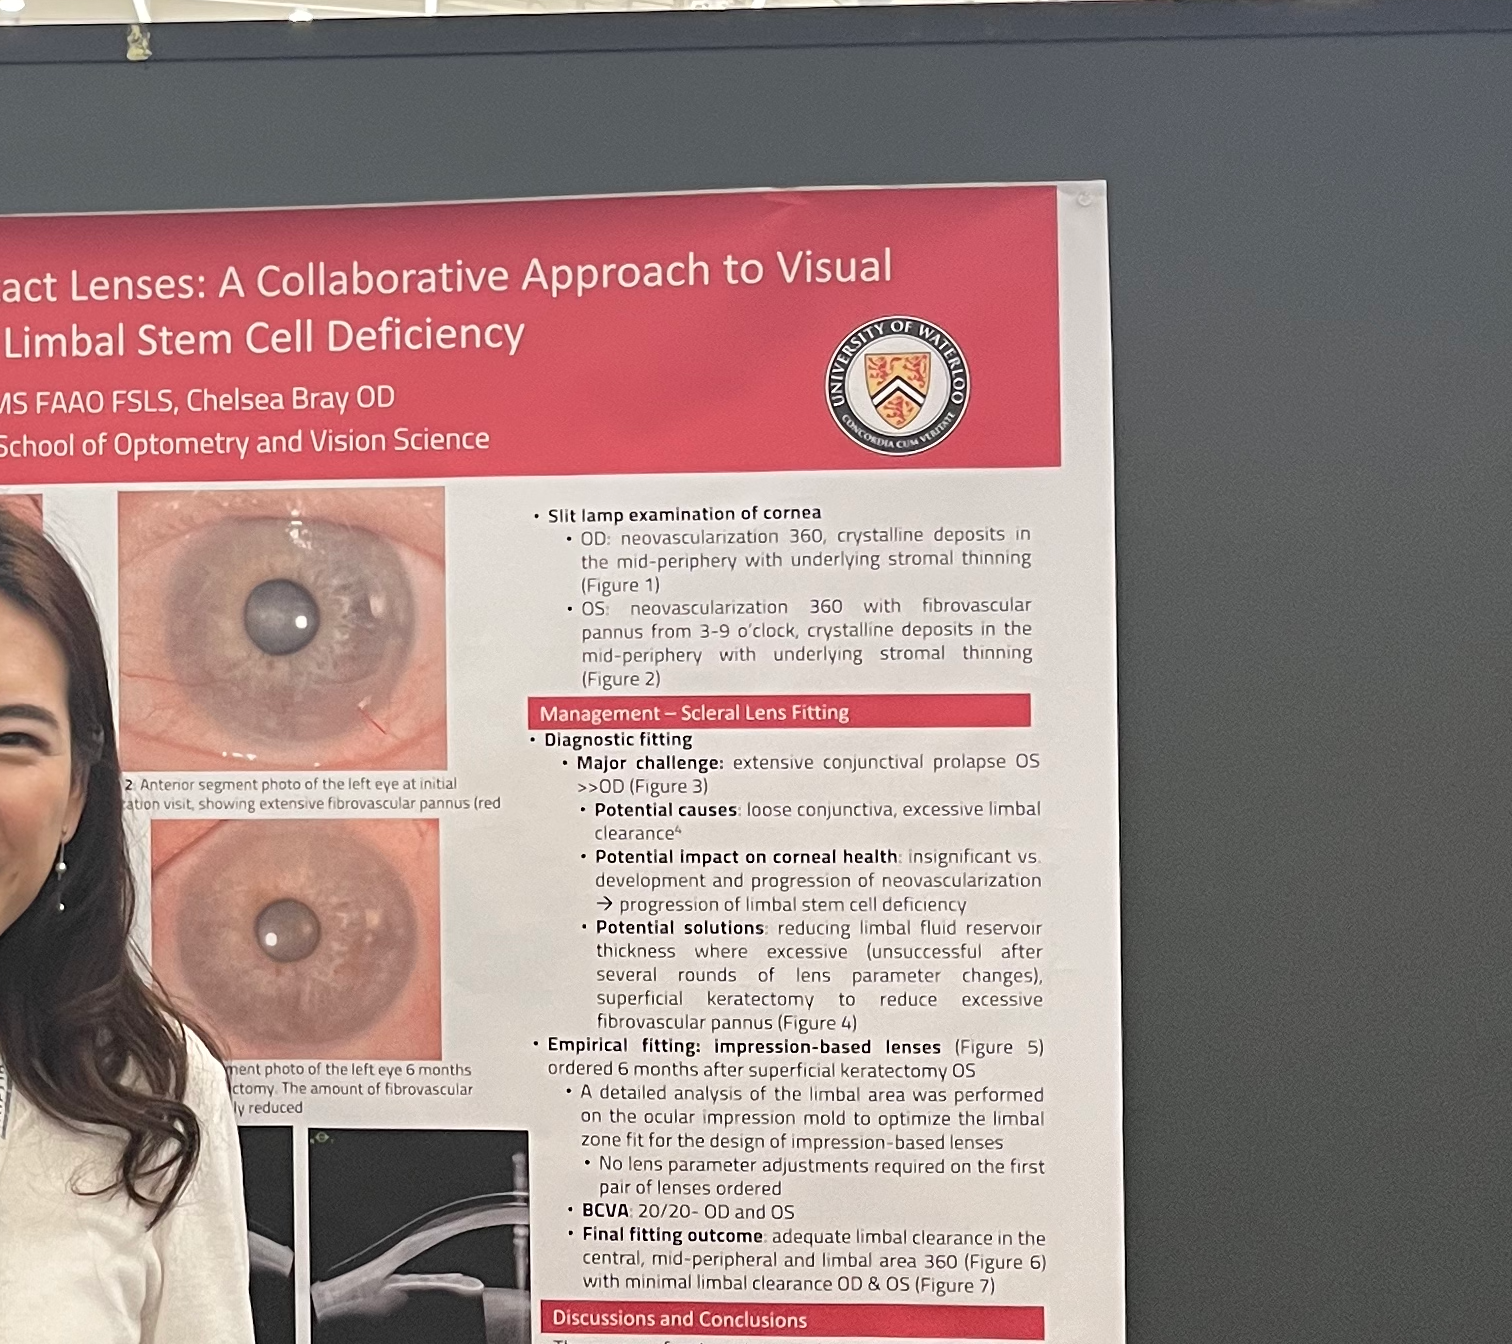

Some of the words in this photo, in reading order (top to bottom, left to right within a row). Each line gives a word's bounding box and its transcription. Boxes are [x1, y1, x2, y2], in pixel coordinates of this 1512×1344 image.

[71, 269, 205, 302] Lenses:
[218, 265, 245, 299] A
[256, 259, 509, 298] Collaborative
[521, 251, 710, 298] Approach
[722, 254, 764, 285] to
[776, 246, 891, 284] Visual
[5, 322, 124, 359] Limbal
[137, 323, 232, 356] Stem
[245, 318, 313, 354] Cell
[328, 316, 525, 356] Deficiency
[831, 322, 884, 407] UNIVERSITY
[890, 320, 913, 333] OF
[918, 323, 966, 405] WATERLOO
[36, 390, 104, 415] FAAO
[112, 388, 179, 416] FSLS,
[186, 386, 285, 412] Chelsea
[292, 386, 350, 416] Bray
[356, 384, 395, 409] OD
[82, 431, 108, 456] of
[114, 432, 250, 462] Optometry
[256, 428, 303, 454] and
[309, 428, 386, 452] Vision
[393, 427, 490, 451] Science
[896, 438, 919, 449] CUM
[548, 508, 576, 524] Slit
[581, 508, 624, 526] lamp
[628, 506, 735, 522] examination
[740, 505, 759, 521] of
[763, 507, 822, 520] cornea
[580, 530, 611, 547] OD:
[621, 529, 779, 546] neovascularization
[789, 528, 827, 545] 360,
[837, 526, 924, 547] crystalline
[933, 526, 1006, 546] deposits
[1015, 529, 1031, 541] in
[581, 577, 639, 598] (Figure
[645, 575, 660, 595] 1)
[540, 705, 661, 726] Management
[681, 703, 740, 722] Scleral
[745, 703, 787, 722] Lens
[791, 703, 850, 724] Fitting
[545, 731, 635, 751] Diagnostic
[639, 731, 693, 751] fitting
[140, 778, 195, 792] Anterior
[198, 779, 259, 795] segment
[261, 777, 302, 794] photo
[304, 776, 319, 791] of
[322, 777, 345, 791] the
[348, 776, 372, 791] left
[374, 780, 400, 794] eye
[402, 778, 417, 790] at
[419, 776, 457, 790] initial
[548, 1036, 628, 1056] Empirical
[642, 1037, 701, 1058] fitting:
[714, 1038, 871, 1058] impression-based
[886, 1039, 941, 1055] lenses
[955, 1038, 1013, 1059] (Figure
[1028, 1038, 1044, 1057] 5)
[249, 1102, 303, 1114] reduced
[638, 1203, 699, 1219] 20/20-
[704, 1203, 730, 1220] OD
[734, 1204, 766, 1220] and
[771, 1204, 795, 1220] OS
[553, 1309, 656, 1327] Discussions
[660, 1310, 695, 1327] and
[699, 1310, 808, 1329] Conclusions
